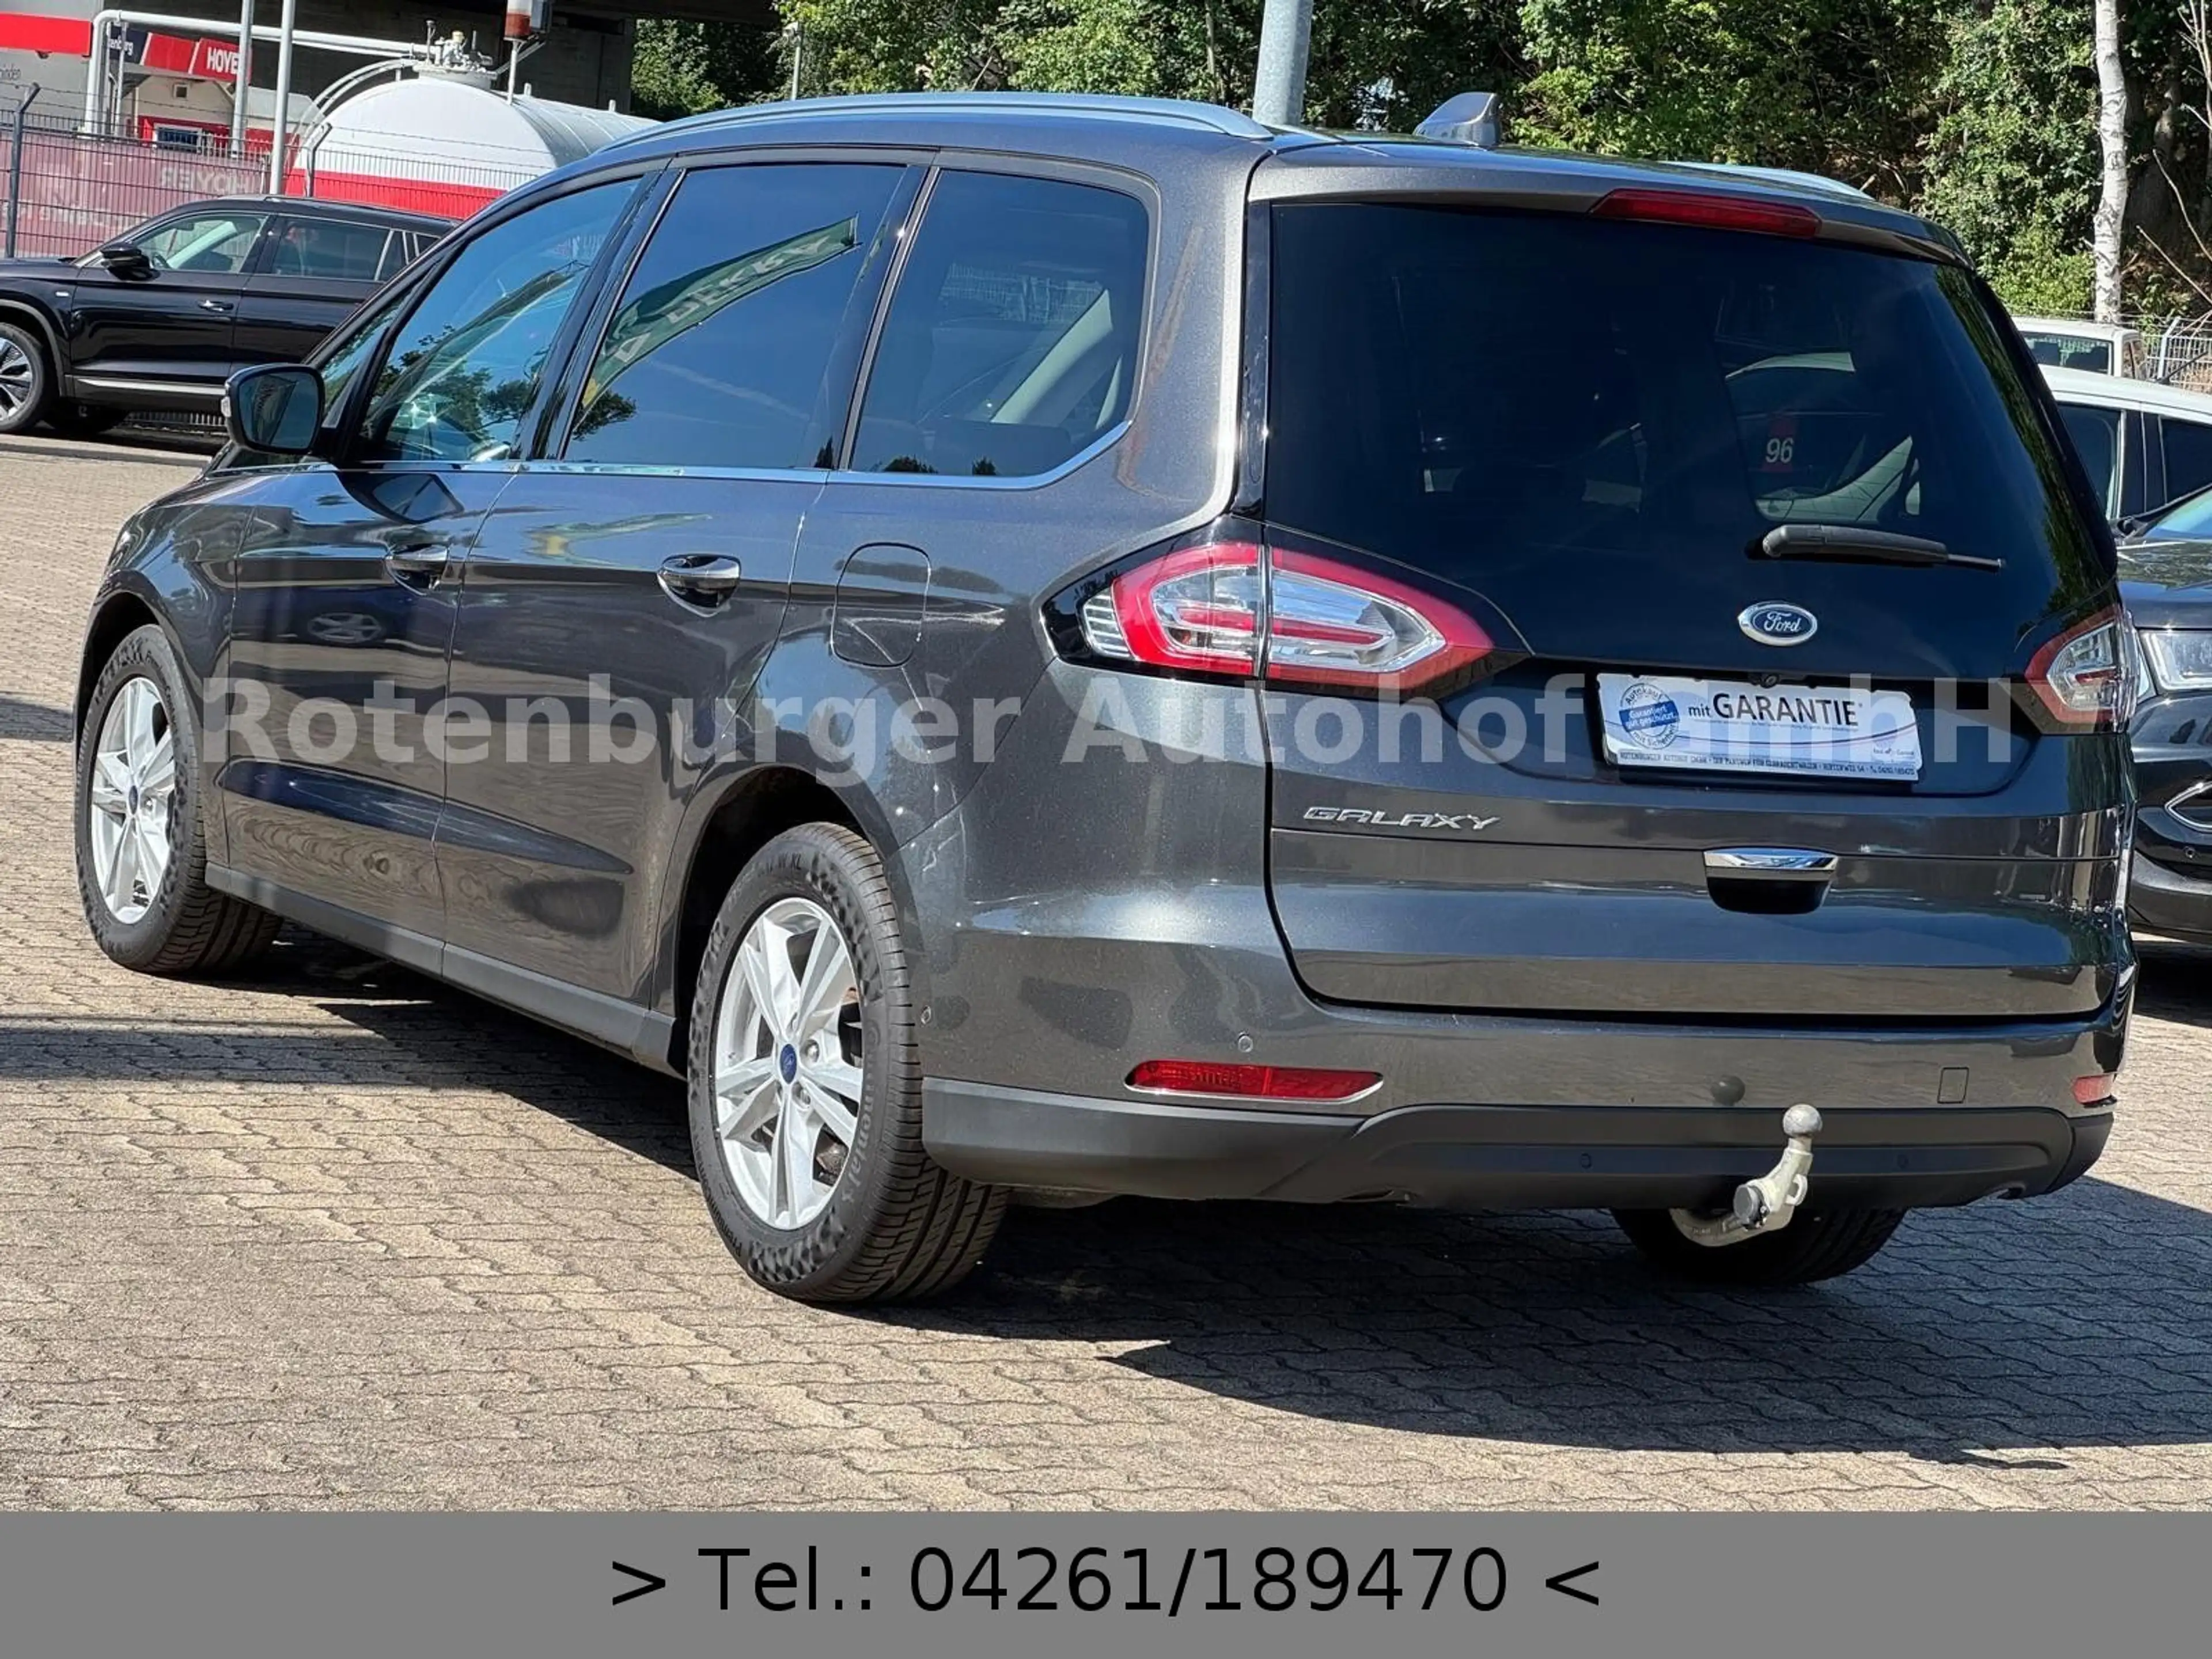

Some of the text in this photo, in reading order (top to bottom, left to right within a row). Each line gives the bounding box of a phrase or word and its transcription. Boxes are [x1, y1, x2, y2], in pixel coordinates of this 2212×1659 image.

[207, 47, 240, 74] HOYE
[1765, 437, 1794, 464] 96
[1764, 611, 1802, 631] Ford
[1688, 701, 1711, 718] mit
[1713, 692, 1858, 726] GARANTIE
[1302, 806, 1501, 831] GALAXY
